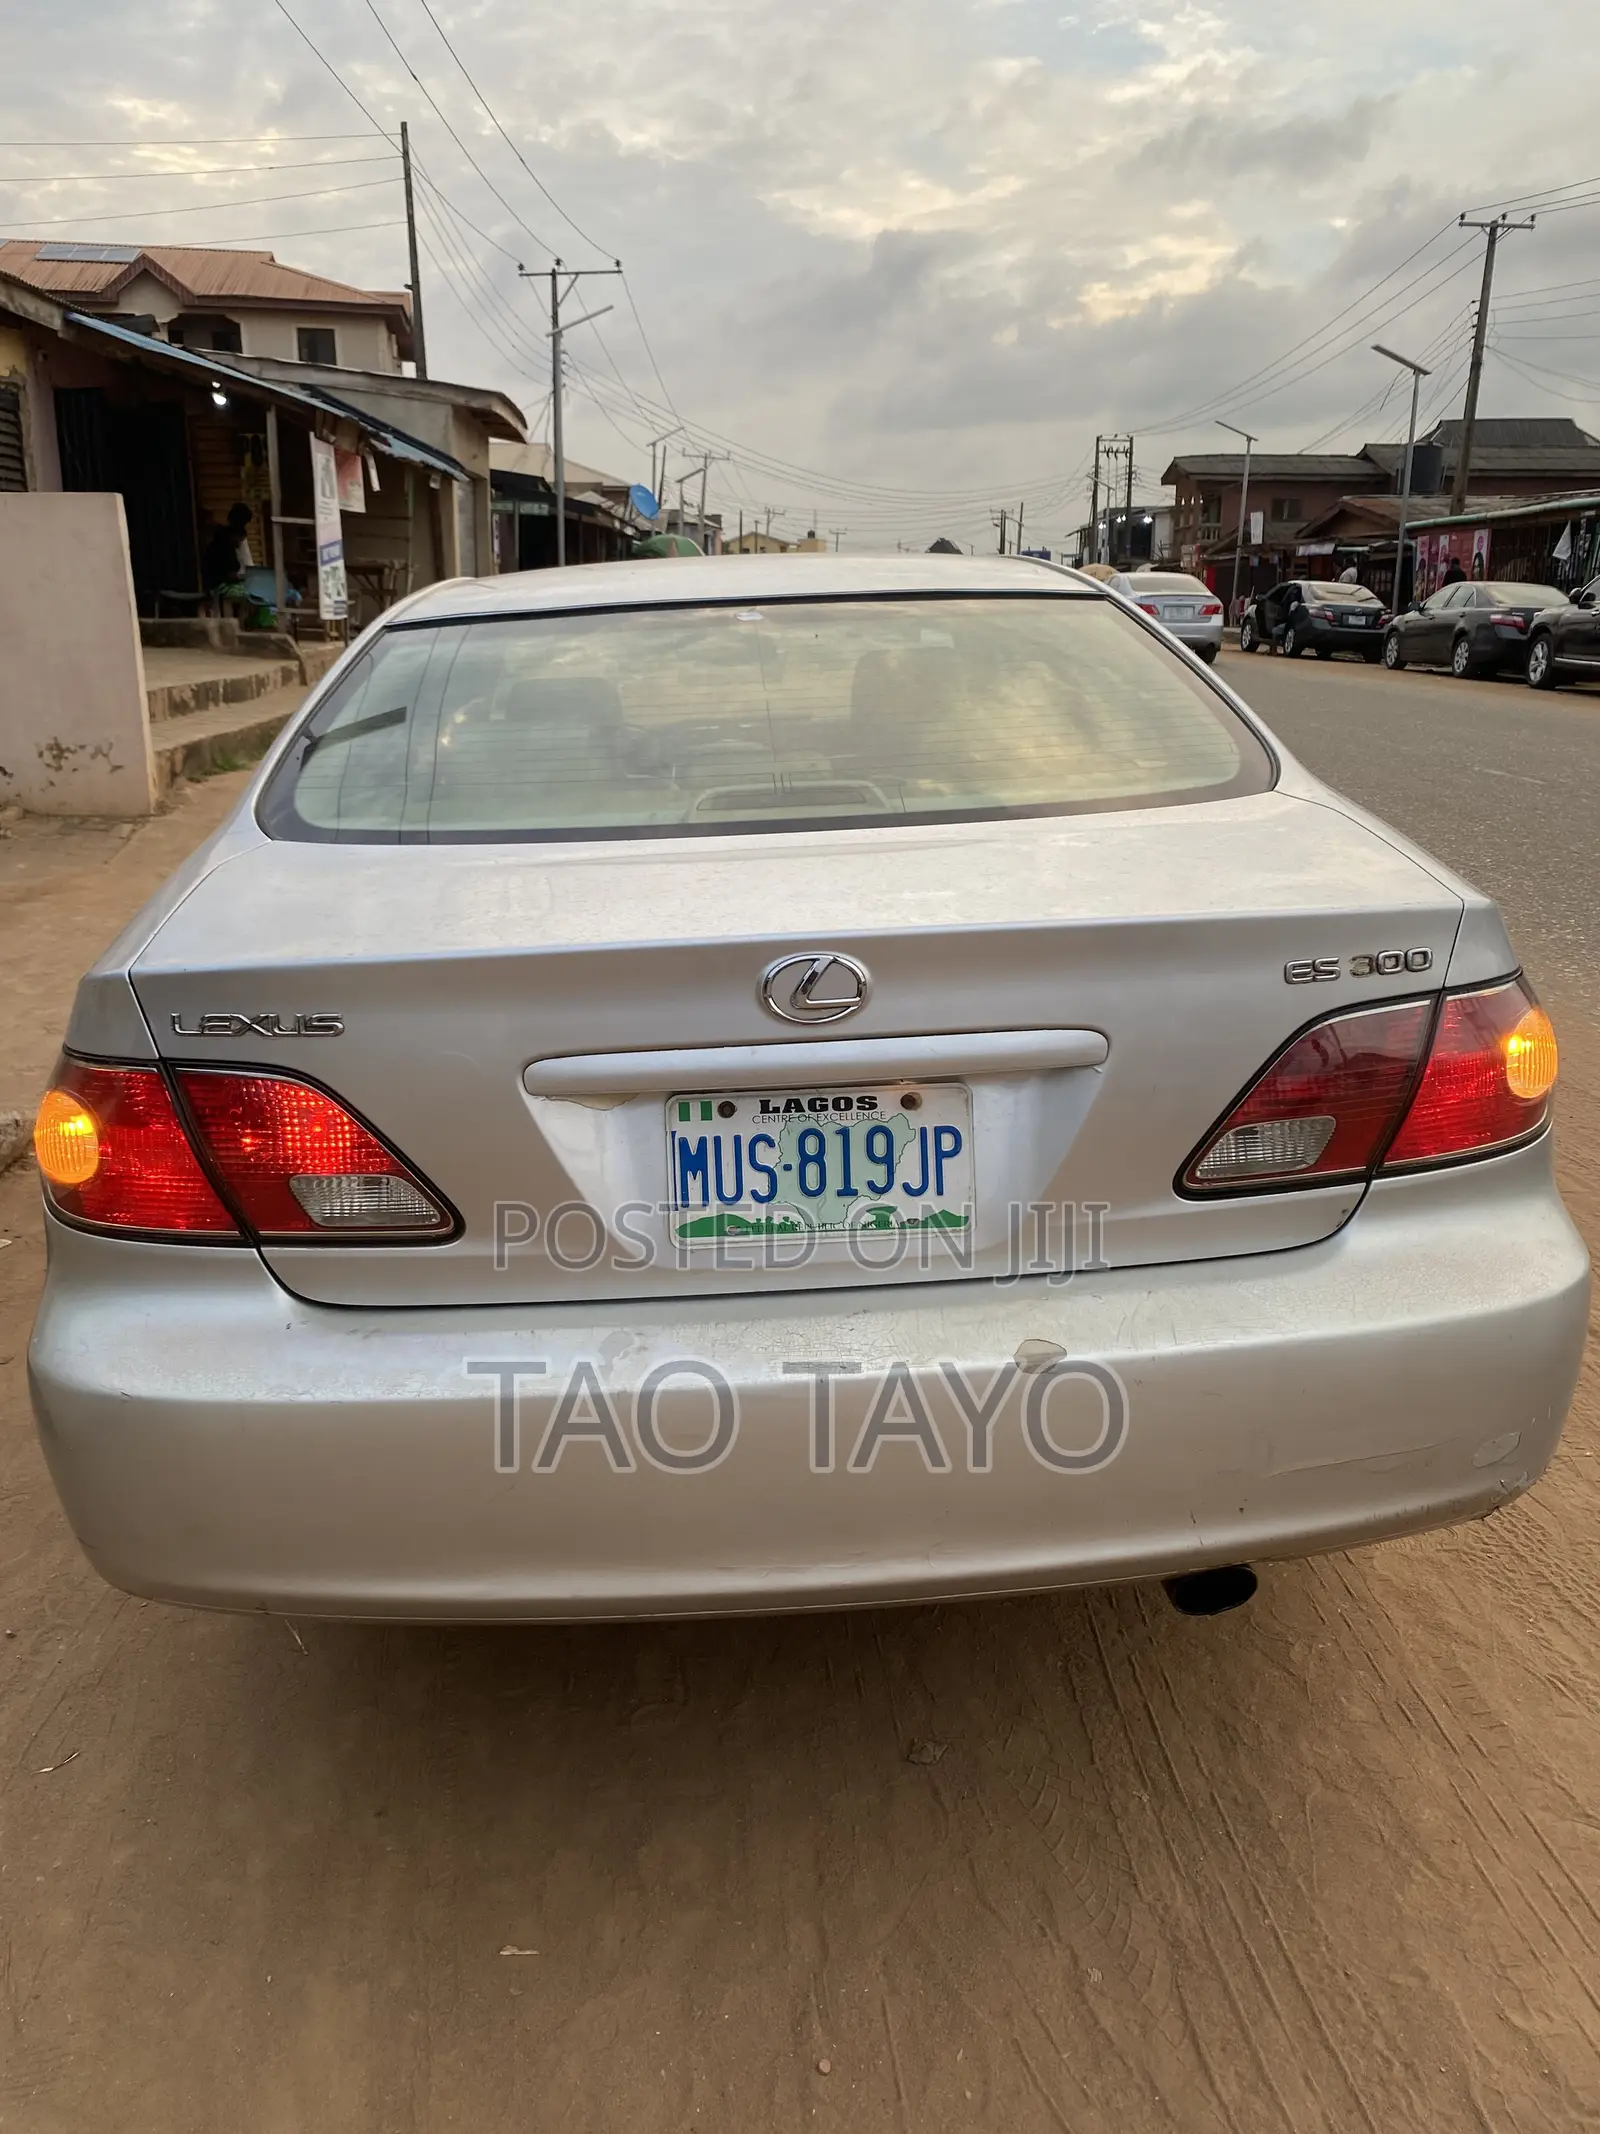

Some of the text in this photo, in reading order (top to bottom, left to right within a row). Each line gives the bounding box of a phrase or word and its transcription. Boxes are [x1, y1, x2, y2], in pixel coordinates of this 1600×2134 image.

[1284, 947, 1433, 984] ES 300
[170, 1012, 345, 1037] LEXUS
[759, 1095, 878, 1114] LAGOS
[752, 1110, 886, 1124] CENTRE OF EXCELLENCE
